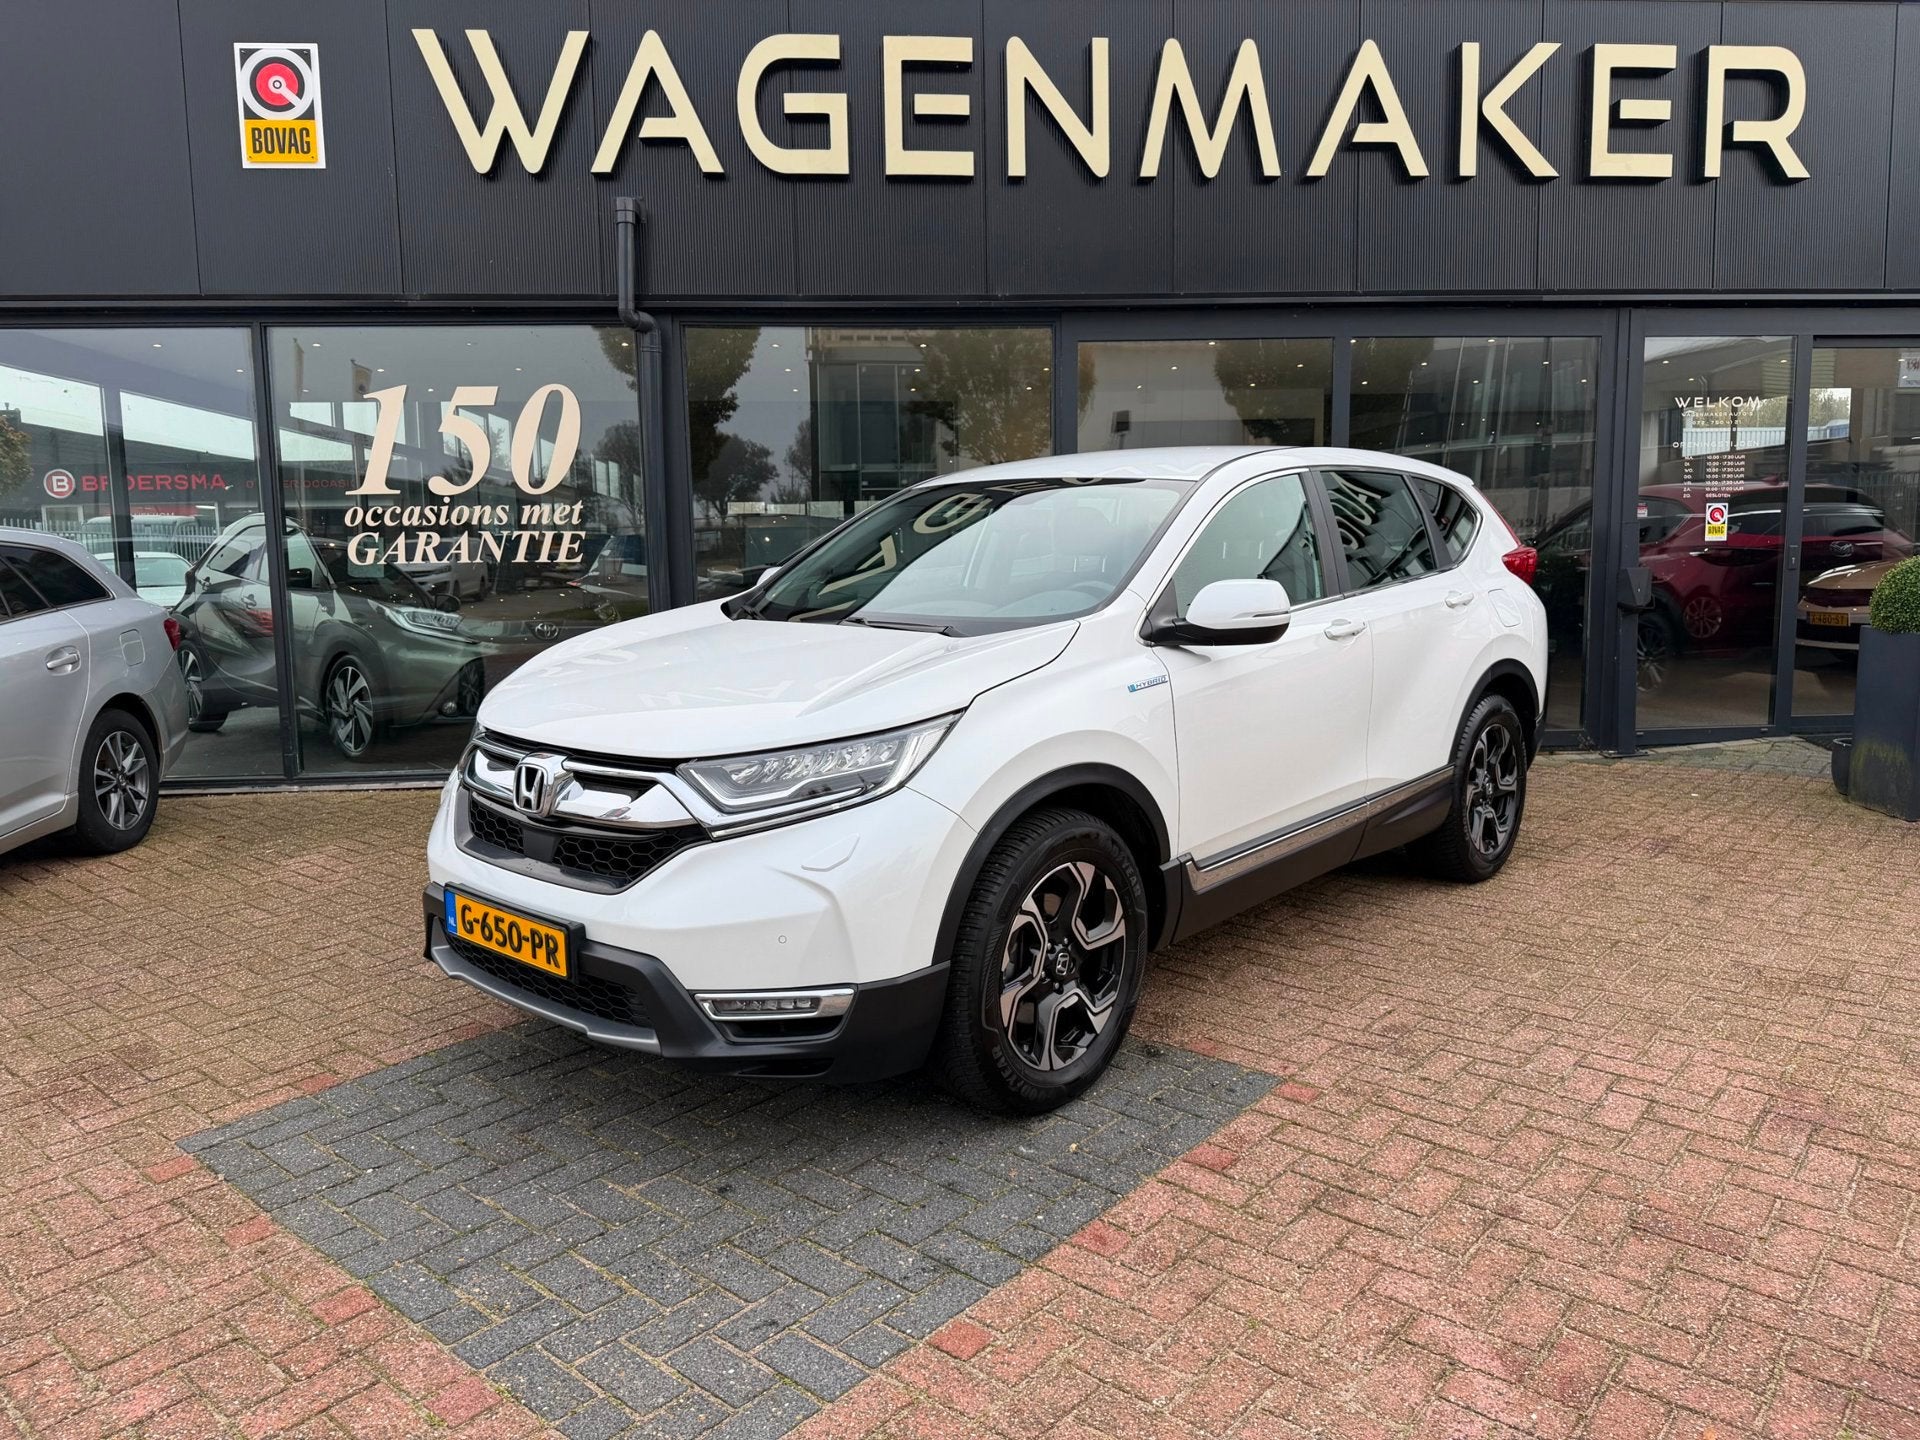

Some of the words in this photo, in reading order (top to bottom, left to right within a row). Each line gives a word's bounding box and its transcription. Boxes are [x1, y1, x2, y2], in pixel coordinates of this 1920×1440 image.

[412, 28, 1810, 180] WAGENMAKER
[251, 126, 311, 155] BOVAG
[1674, 395, 1761, 408] WELKOM
[345, 383, 581, 496] 150
[344, 496, 510, 527] occasions
[520, 500, 584, 526] met
[347, 530, 586, 565] GARANTIE
[1136, 676, 1167, 688] HYBRID
[461, 903, 561, 969] G-650-PR
